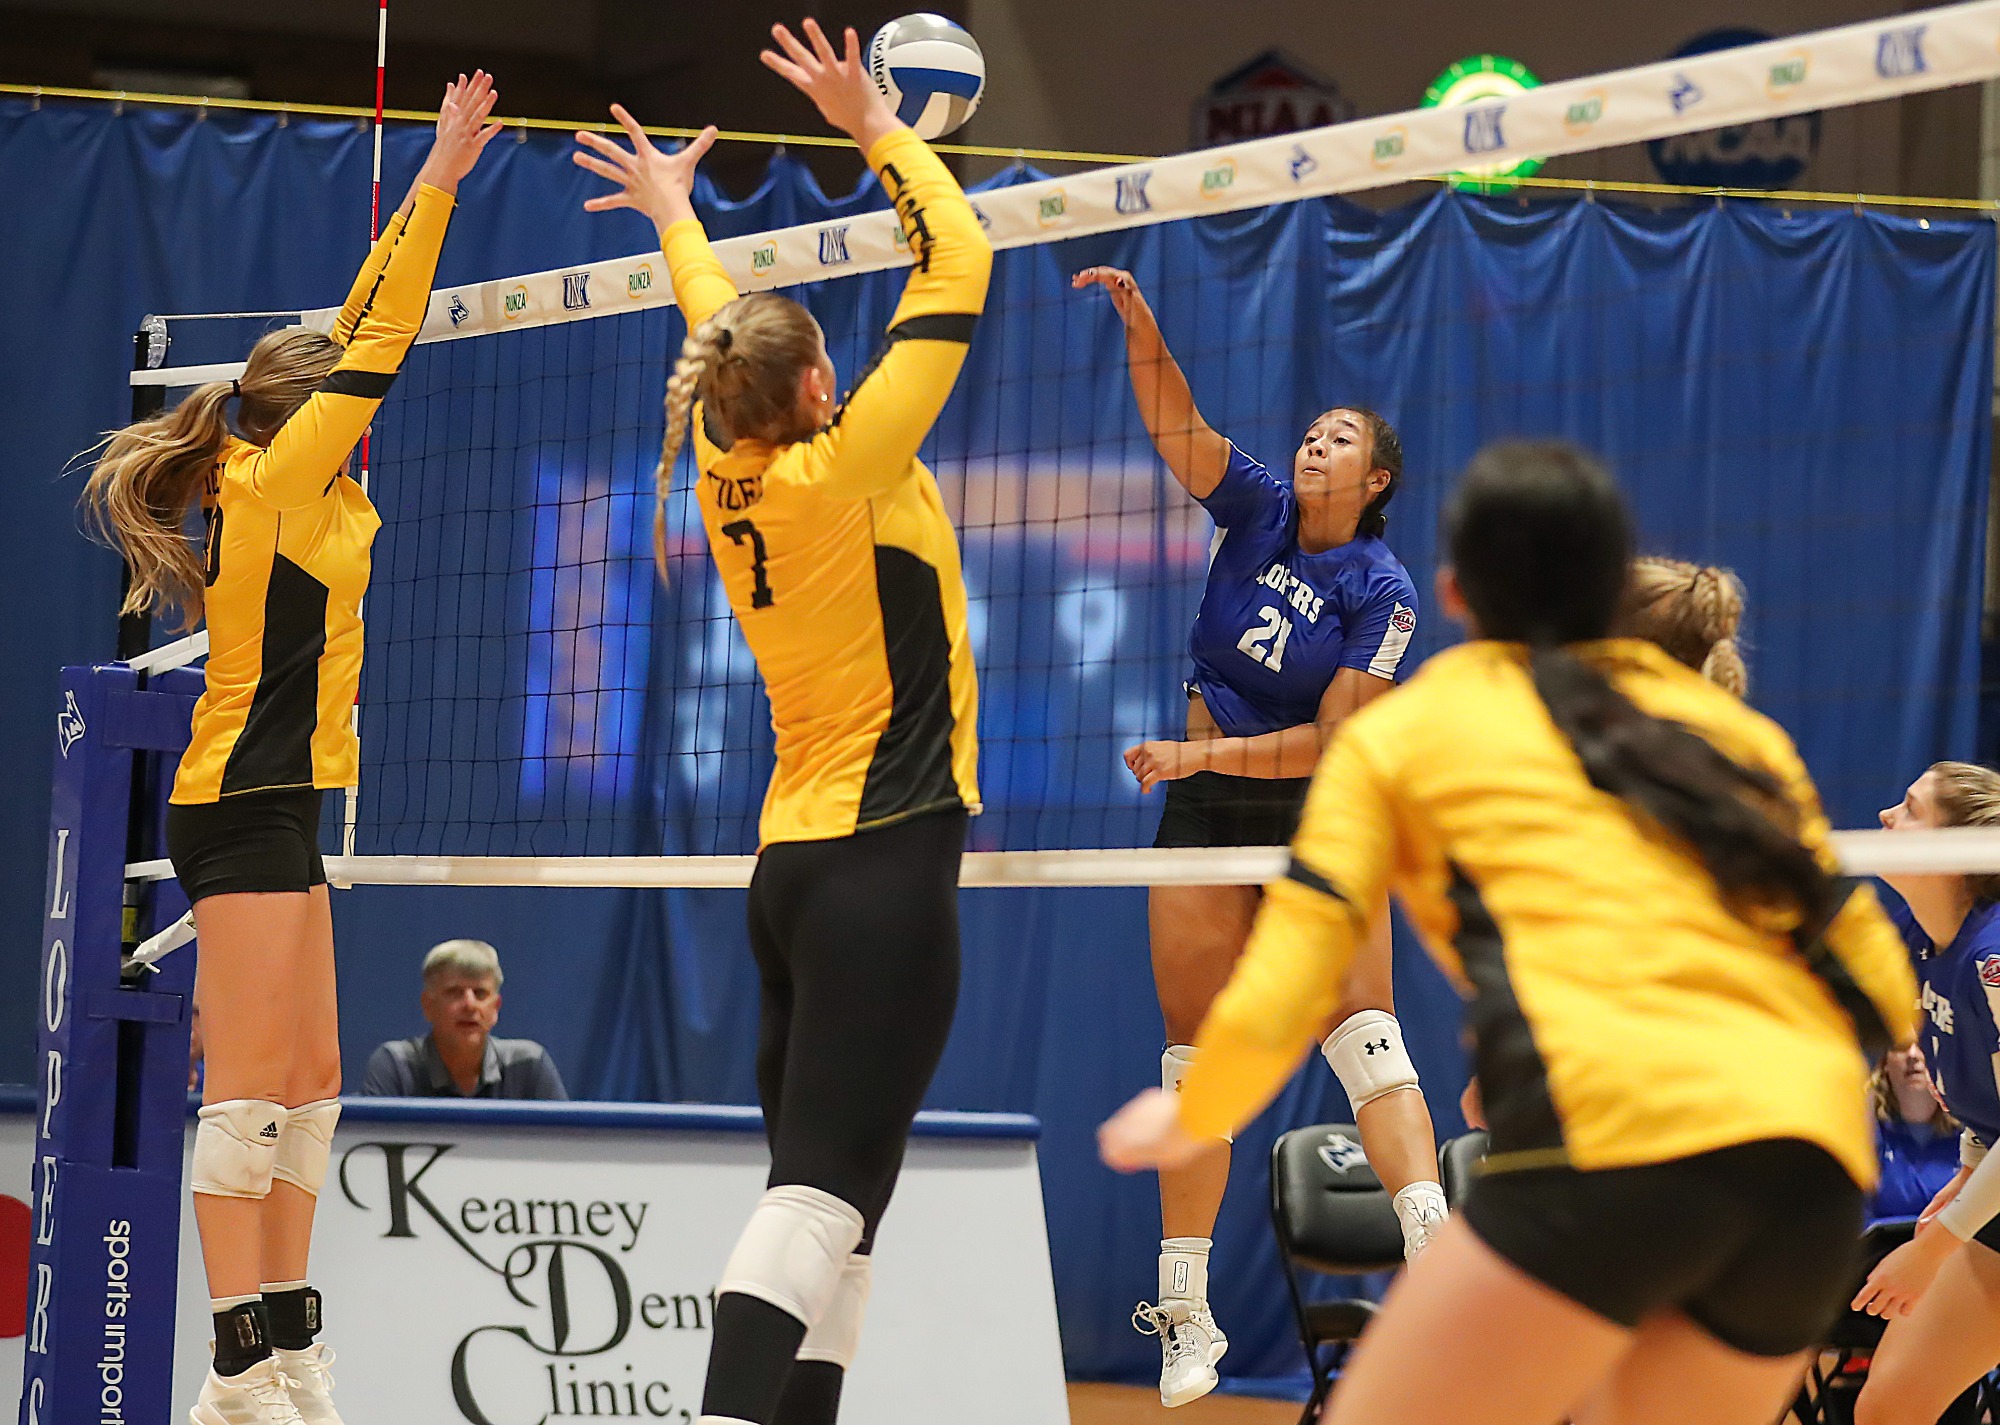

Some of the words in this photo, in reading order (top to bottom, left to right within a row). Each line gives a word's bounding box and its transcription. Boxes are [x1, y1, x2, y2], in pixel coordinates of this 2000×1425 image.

[872, 31, 888, 95] molten
[753, 248, 776, 269] RUNZA
[818, 224, 851, 266] UNK
[505, 292, 527, 312] RUNZA
[562, 272, 592, 311] UNK
[628, 271, 652, 291] RUNZA
[721, 518, 775, 610] 7
[1236, 605, 1293, 674] 21
[339, 1142, 650, 1276] Kearney
[103, 1219, 132, 1319] sports
[504, 1240, 717, 1356] Dent
[450, 1325, 692, 1425] Clinic,
